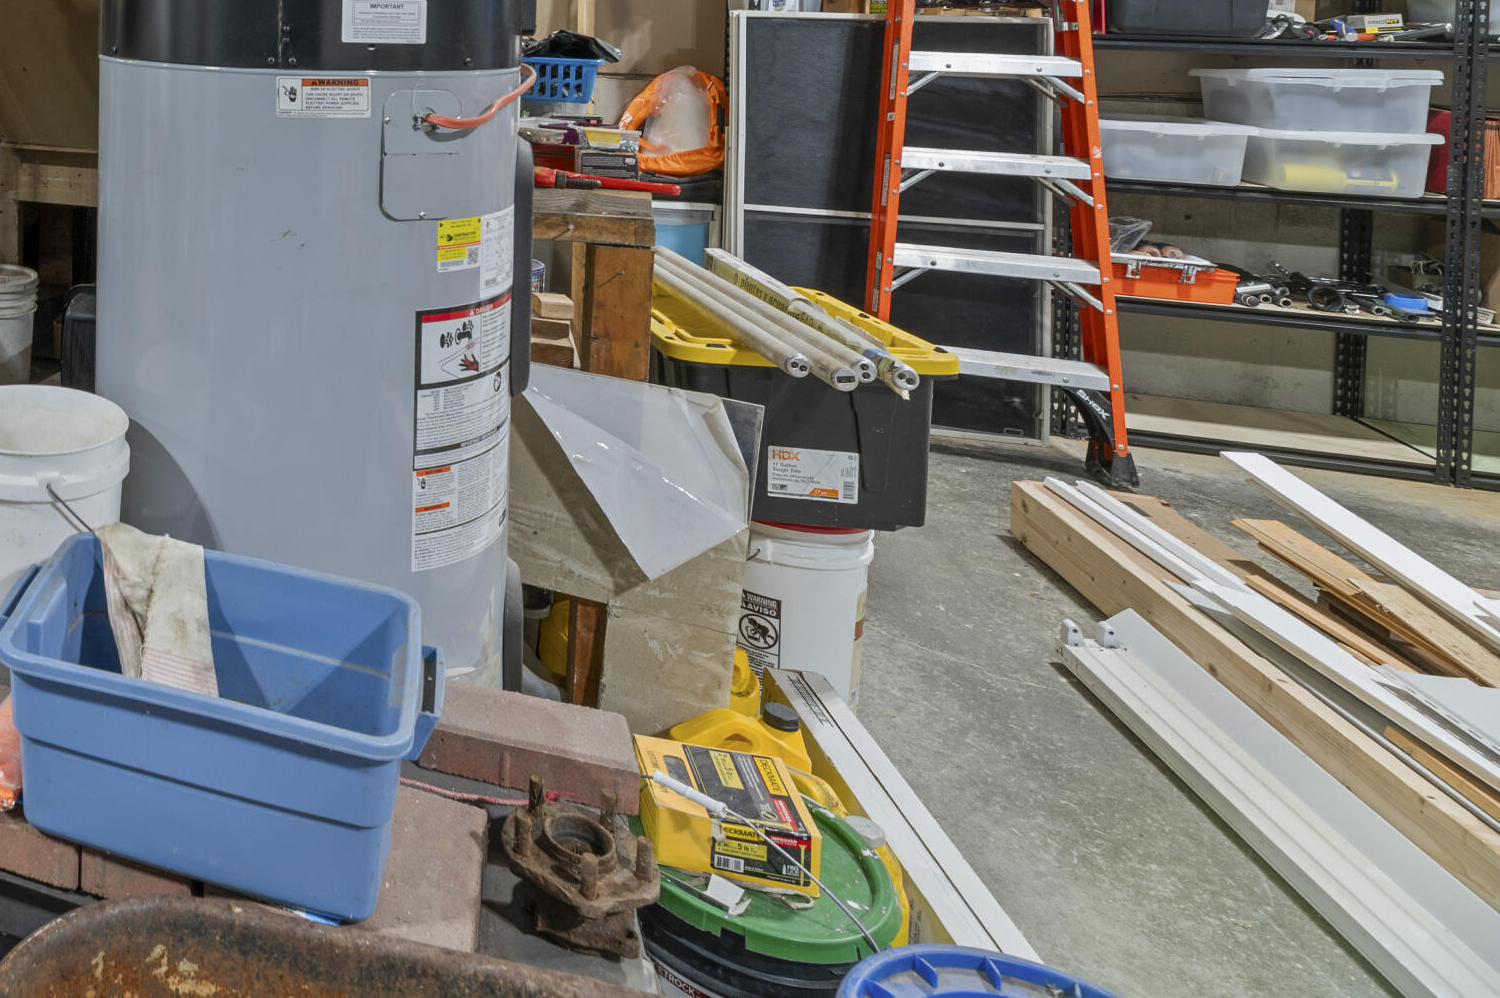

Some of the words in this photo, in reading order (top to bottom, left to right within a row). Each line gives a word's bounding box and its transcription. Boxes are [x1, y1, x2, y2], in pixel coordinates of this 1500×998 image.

[317, 78, 360, 86] WARNING
[1077, 389, 1110, 420] SHOX
[772, 450, 800, 461] HDX
[746, 592, 777, 608] WARNING
[746, 603, 777, 616] AVISO
[759, 759, 783, 793] DECKMATE
[722, 826, 761, 839] ECKMAT
